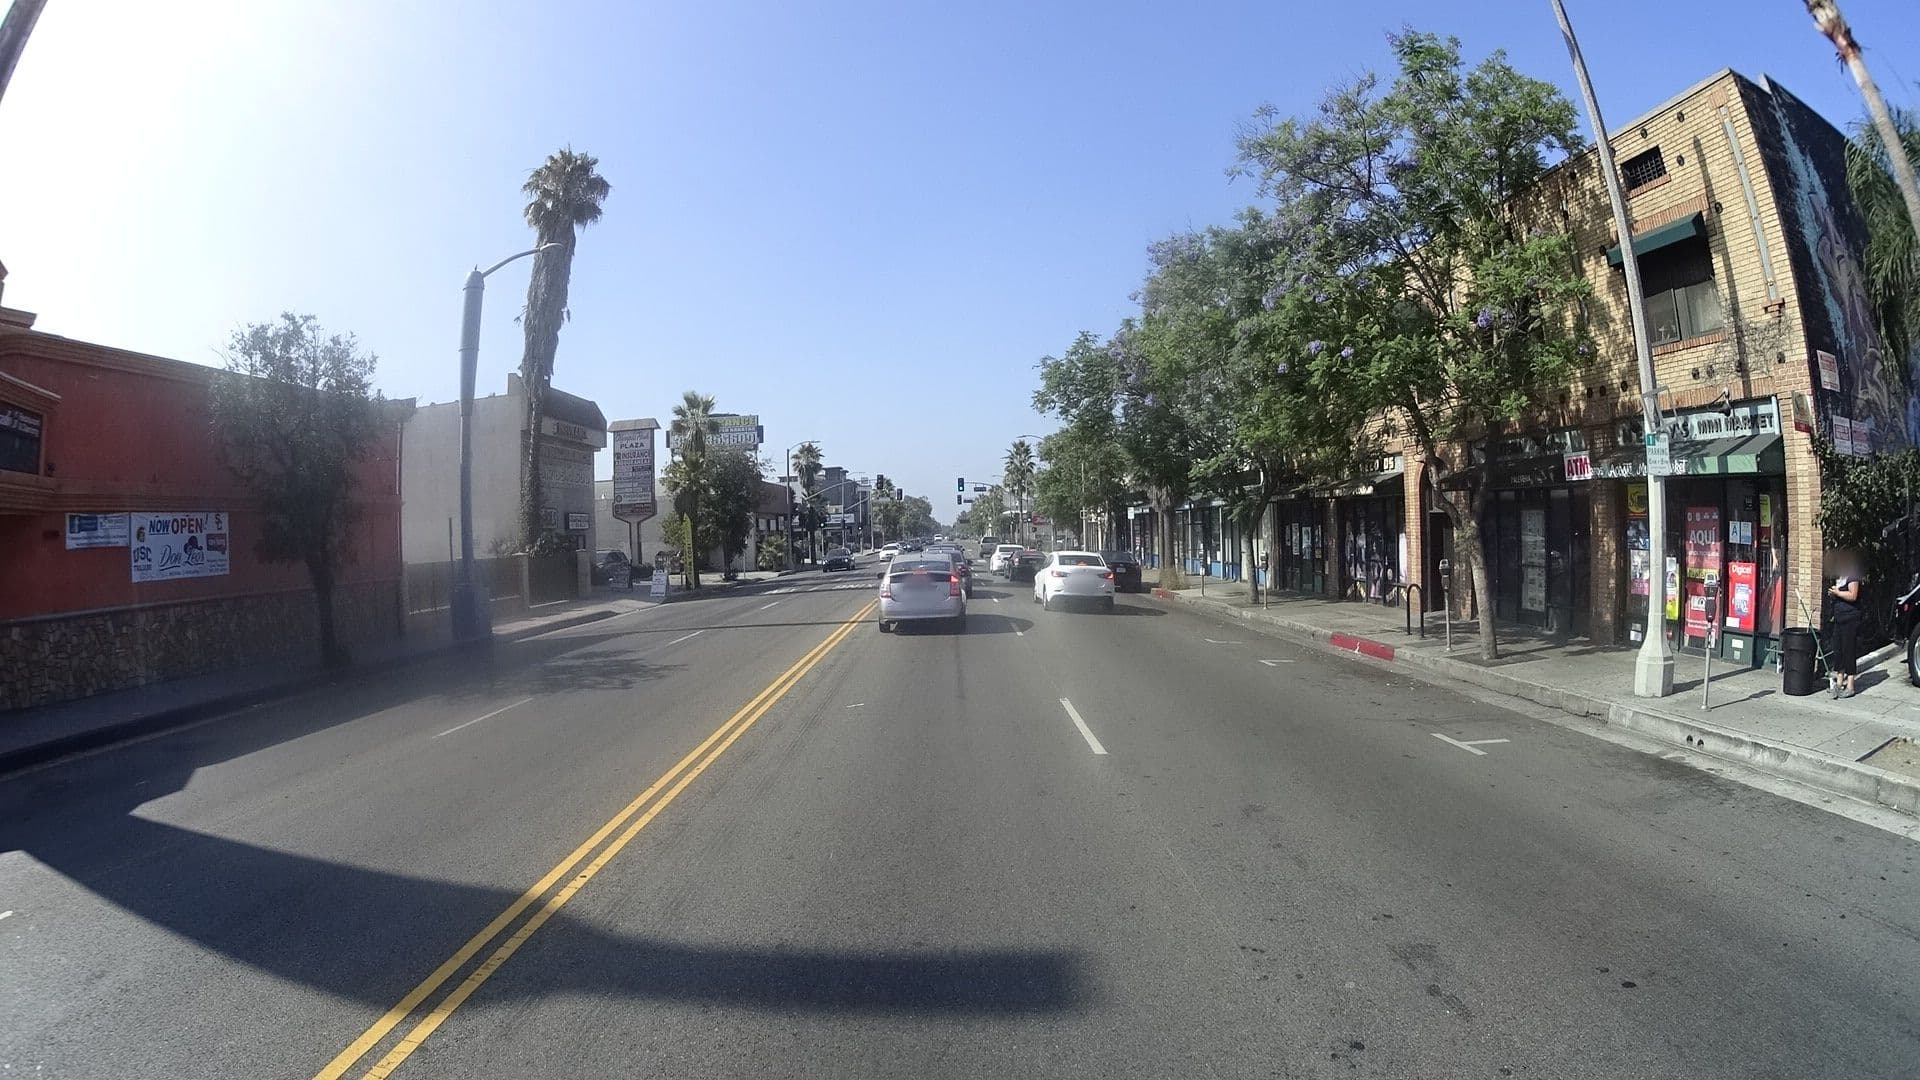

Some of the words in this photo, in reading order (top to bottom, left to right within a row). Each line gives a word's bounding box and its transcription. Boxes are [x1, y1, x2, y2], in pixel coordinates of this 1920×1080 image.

[1697, 416, 1722, 435] MINI
[1726, 413, 1774, 432] MARKET
[1567, 456, 1592, 477] ATM
[149, 519, 171, 534] NOW
[1731, 525, 1738, 536] A
[1689, 528, 1716, 546] AQUÍ
[133, 546, 152, 562] USC
[160, 545, 182, 568] Don
[1731, 565, 1752, 575] Digicel
